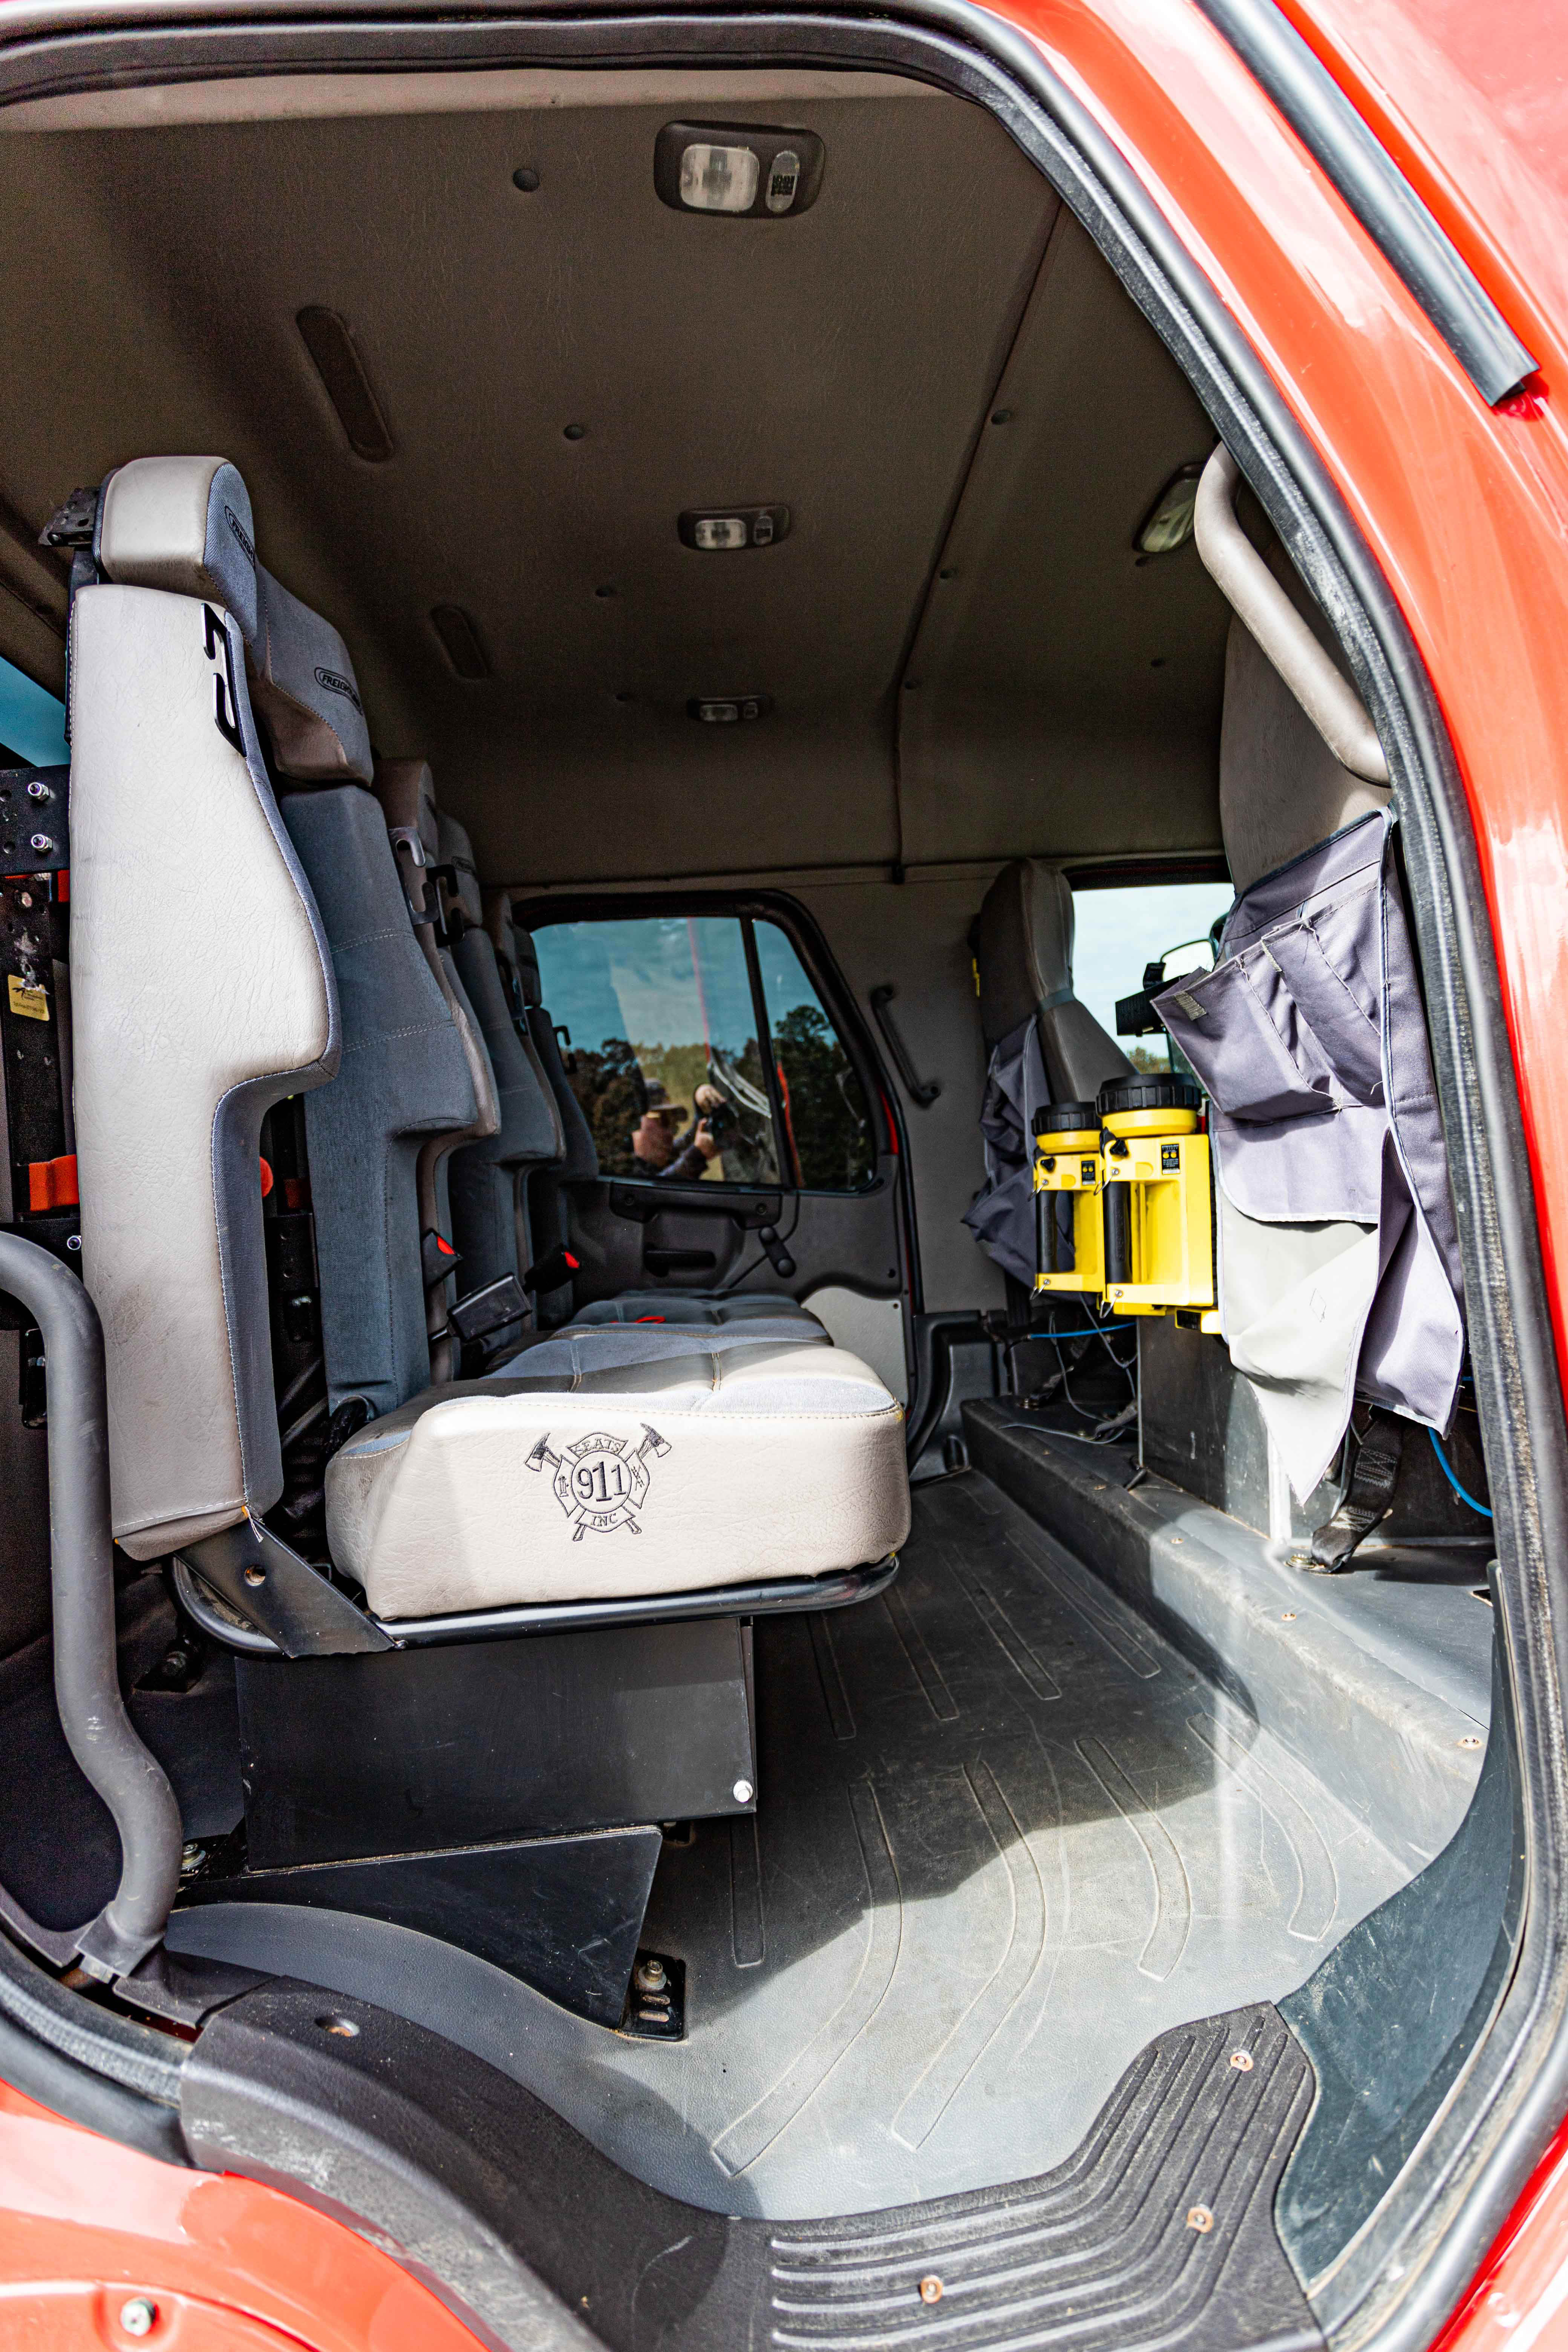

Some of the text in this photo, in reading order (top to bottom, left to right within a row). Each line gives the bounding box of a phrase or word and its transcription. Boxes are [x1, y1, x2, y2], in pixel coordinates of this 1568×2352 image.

[575, 1438, 622, 1454] SEATS
[577, 1461, 626, 1502] 911
[592, 1513, 618, 1527] INC
